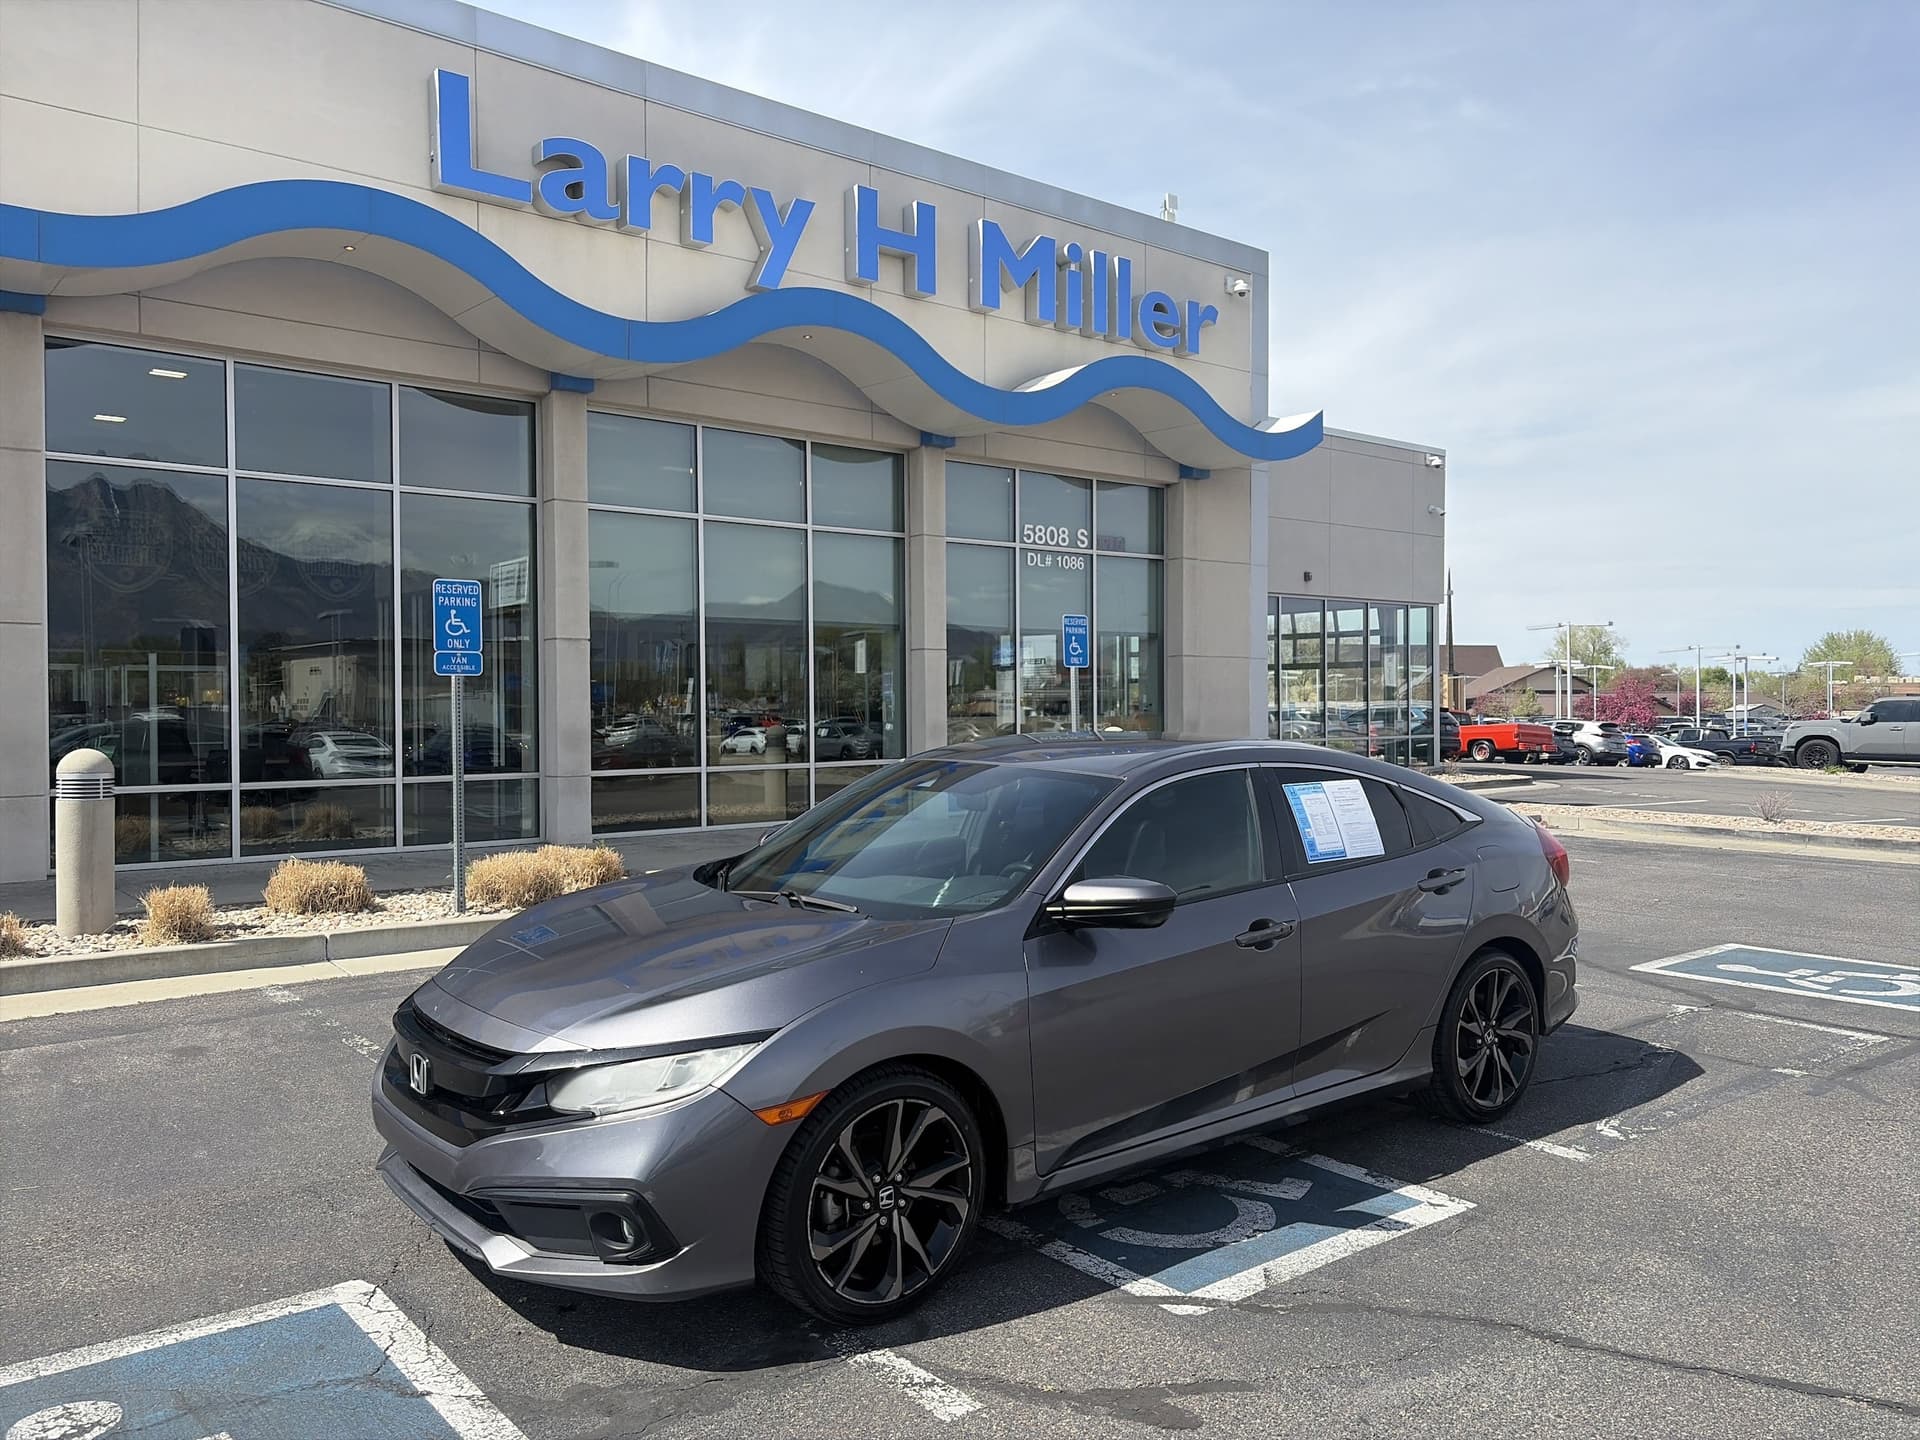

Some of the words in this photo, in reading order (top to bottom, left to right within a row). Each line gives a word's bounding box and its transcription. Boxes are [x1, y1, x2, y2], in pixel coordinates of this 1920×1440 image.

[430, 68, 815, 291] Larry
[845, 184, 936, 298] H
[968, 218, 1219, 355] Miller
[1023, 524, 1069, 547] 5808
[1077, 529, 1089, 548] S
[1027, 552, 1052, 568] DL#
[1056, 555, 1085, 570] 1086
[435, 583, 479, 595] RESERVED
[438, 596, 477, 607] PARKING
[1064, 618, 1087, 626] RESERVED
[447, 639, 471, 649] ONLY
[452, 656, 468, 664] VAN
